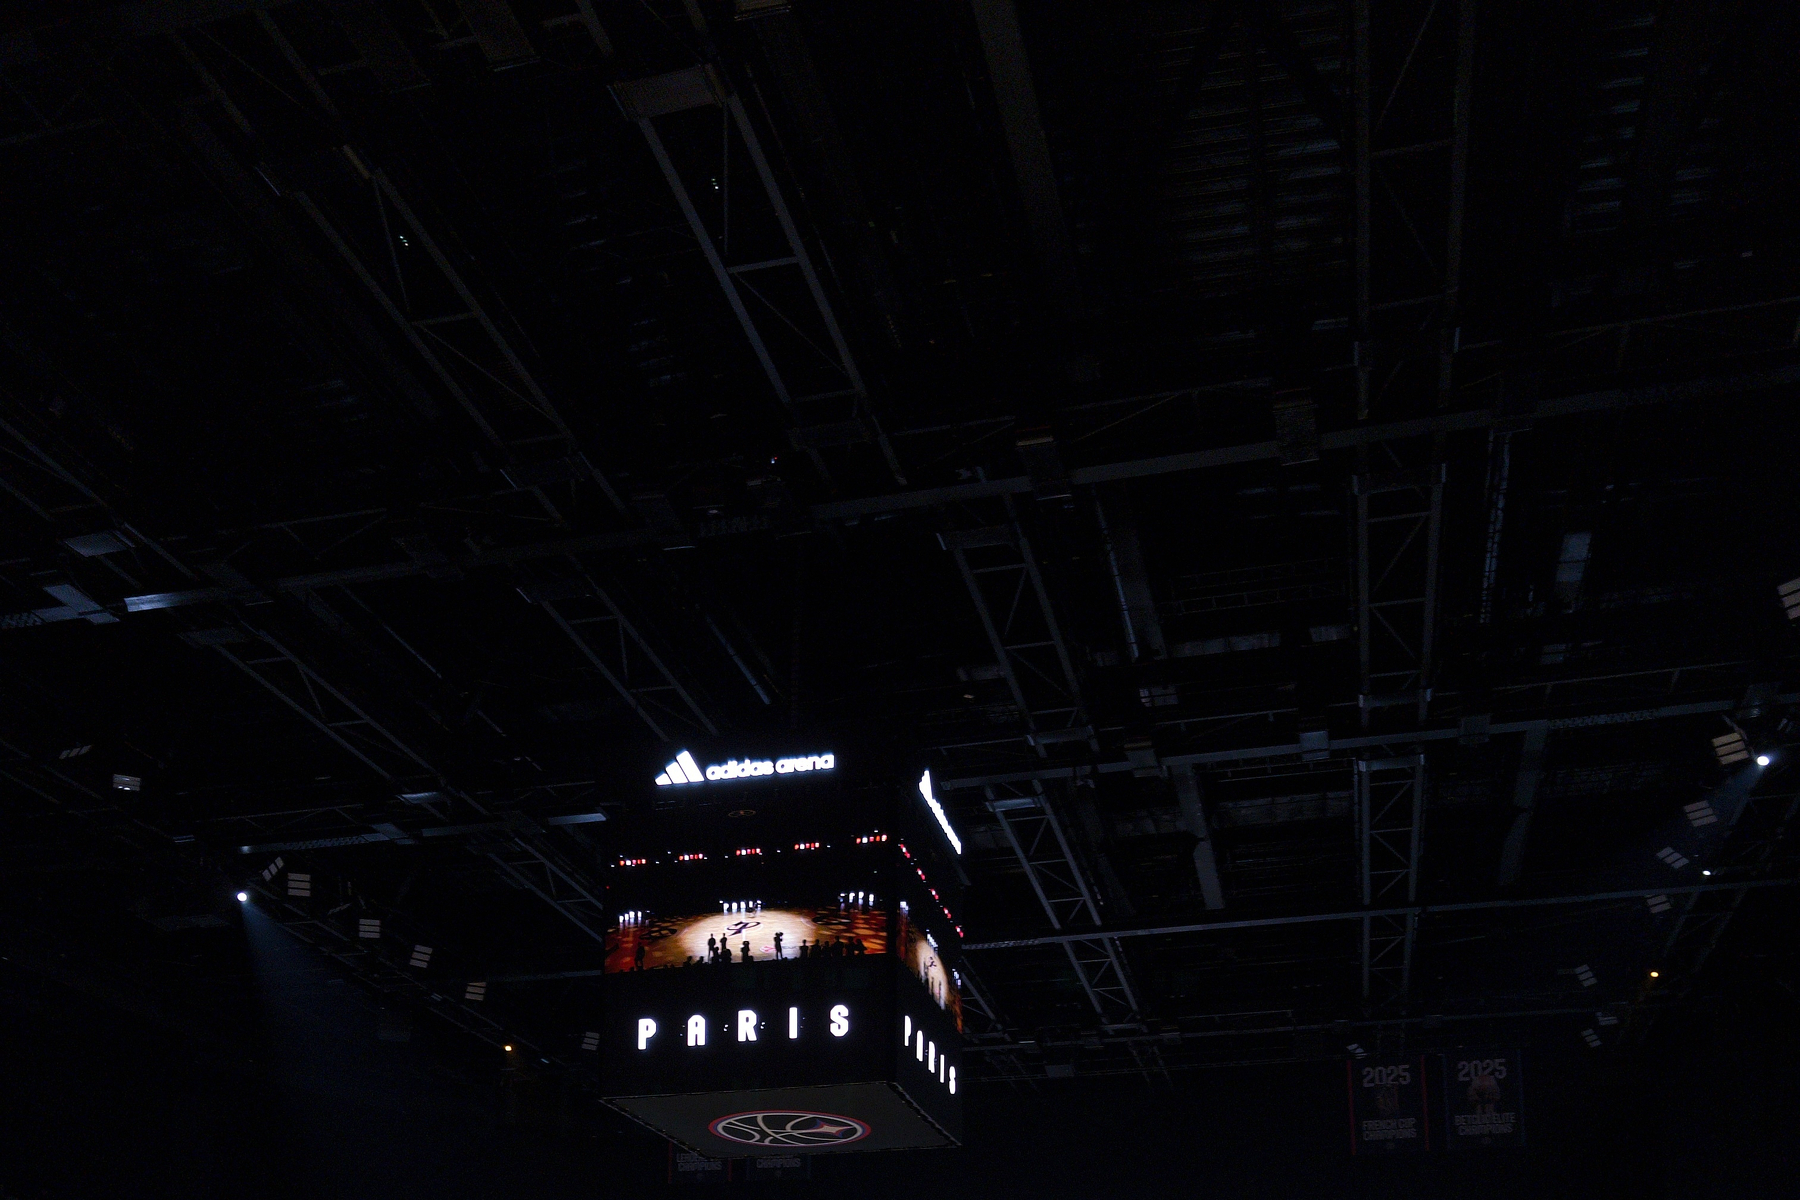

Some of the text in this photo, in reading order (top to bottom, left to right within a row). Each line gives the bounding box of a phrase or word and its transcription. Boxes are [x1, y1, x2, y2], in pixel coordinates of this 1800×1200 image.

[706, 754, 834, 781] adidas arena
[1362, 1064, 1411, 1088] 2025
[1458, 1058, 1507, 1082] 2025
